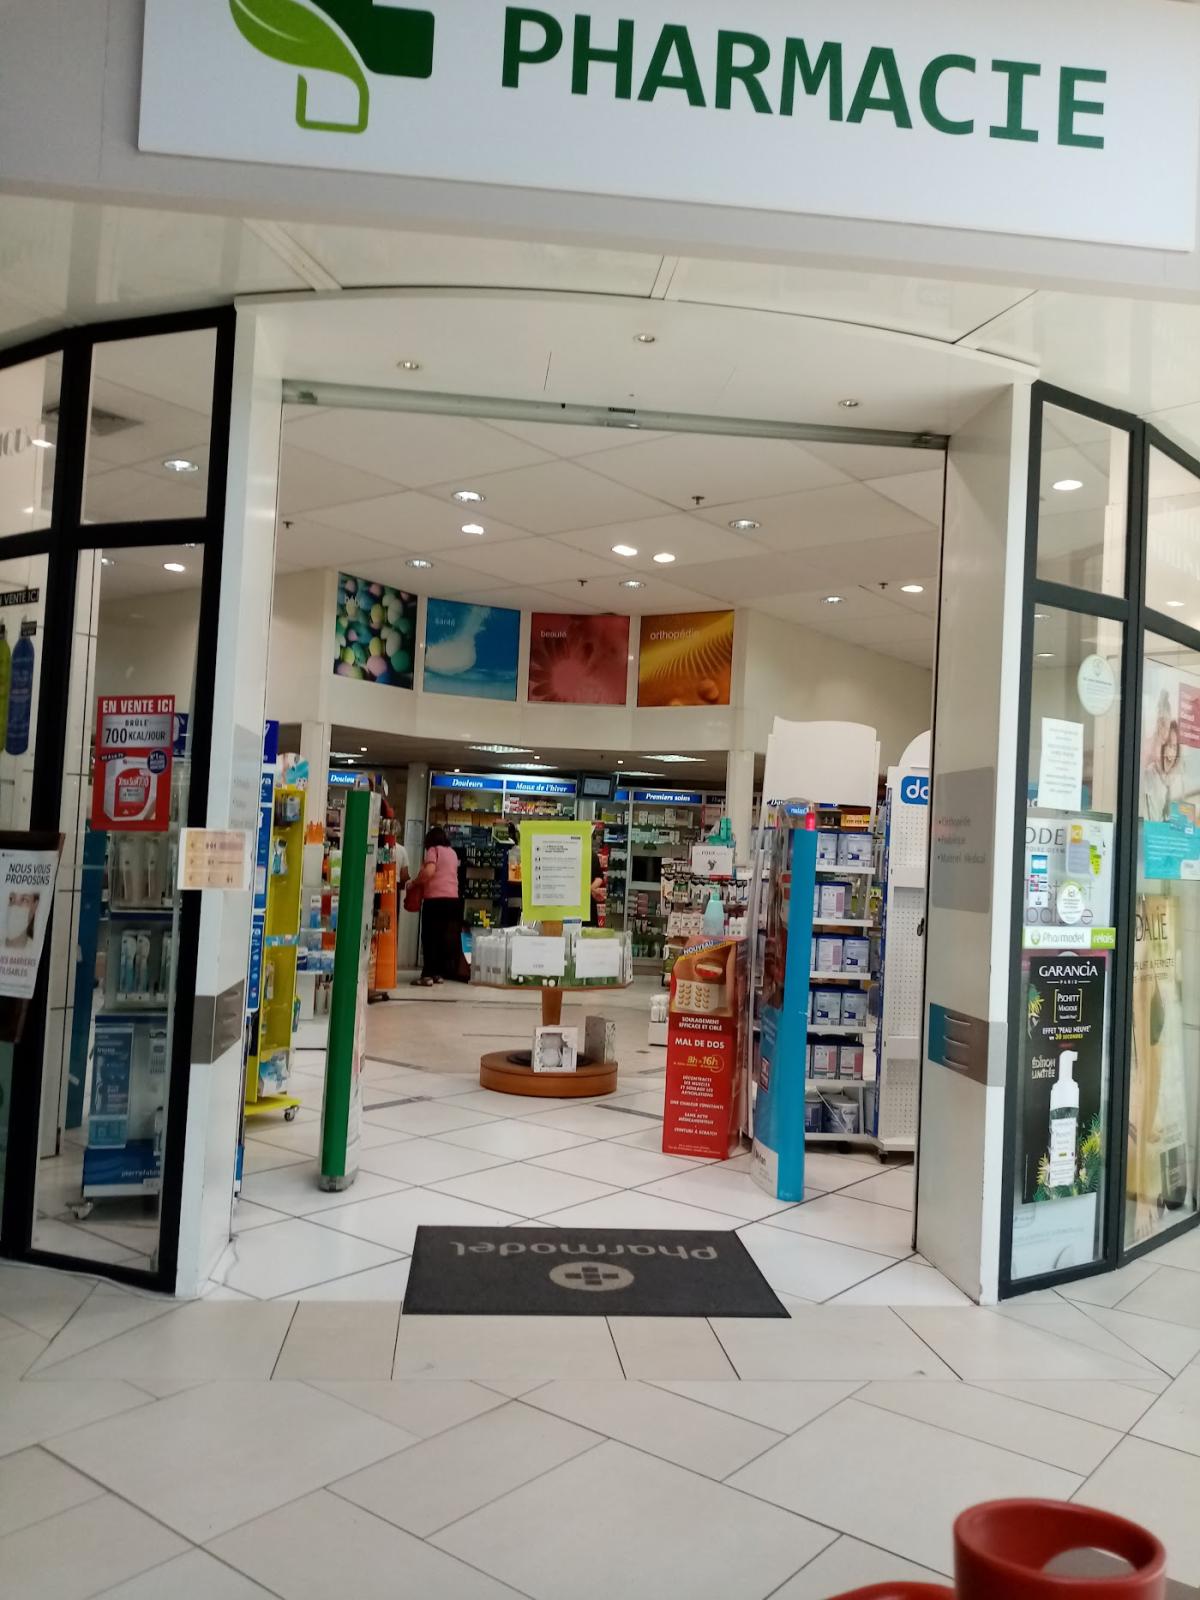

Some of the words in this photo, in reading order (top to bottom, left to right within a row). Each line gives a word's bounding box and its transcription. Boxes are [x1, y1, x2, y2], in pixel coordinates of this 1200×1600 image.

[502, 7, 1107, 149] PHARMACIE
[650, 628, 700, 641] orthopédie
[103, 700, 117, 713] EN
[121, 700, 154, 713] VENTE
[158, 699, 172, 712] ICI
[105, 728, 127, 744] 700
[128, 731, 166, 741] KCAL/JOUR
[330, 774, 355, 784] Douleu
[452, 779, 483, 788] Douleurs
[9, 864, 32, 874] NOUS
[33, 864, 51, 875] VOUS
[5, 874, 50, 886] PROPOSONS
[684, 939, 714, 955] NOUVEAU
[1057, 993, 1080, 1002] PSCHITT
[682, 1016, 719, 1025] SOULAGEMENT
[1043, 1026, 1056, 1034] EFFET
[675, 1038, 692, 1046] MAL
[694, 1039, 705, 1047] DE
[707, 1041, 724, 1049] DOS
[450, 1241, 718, 1260] Pharmodel
